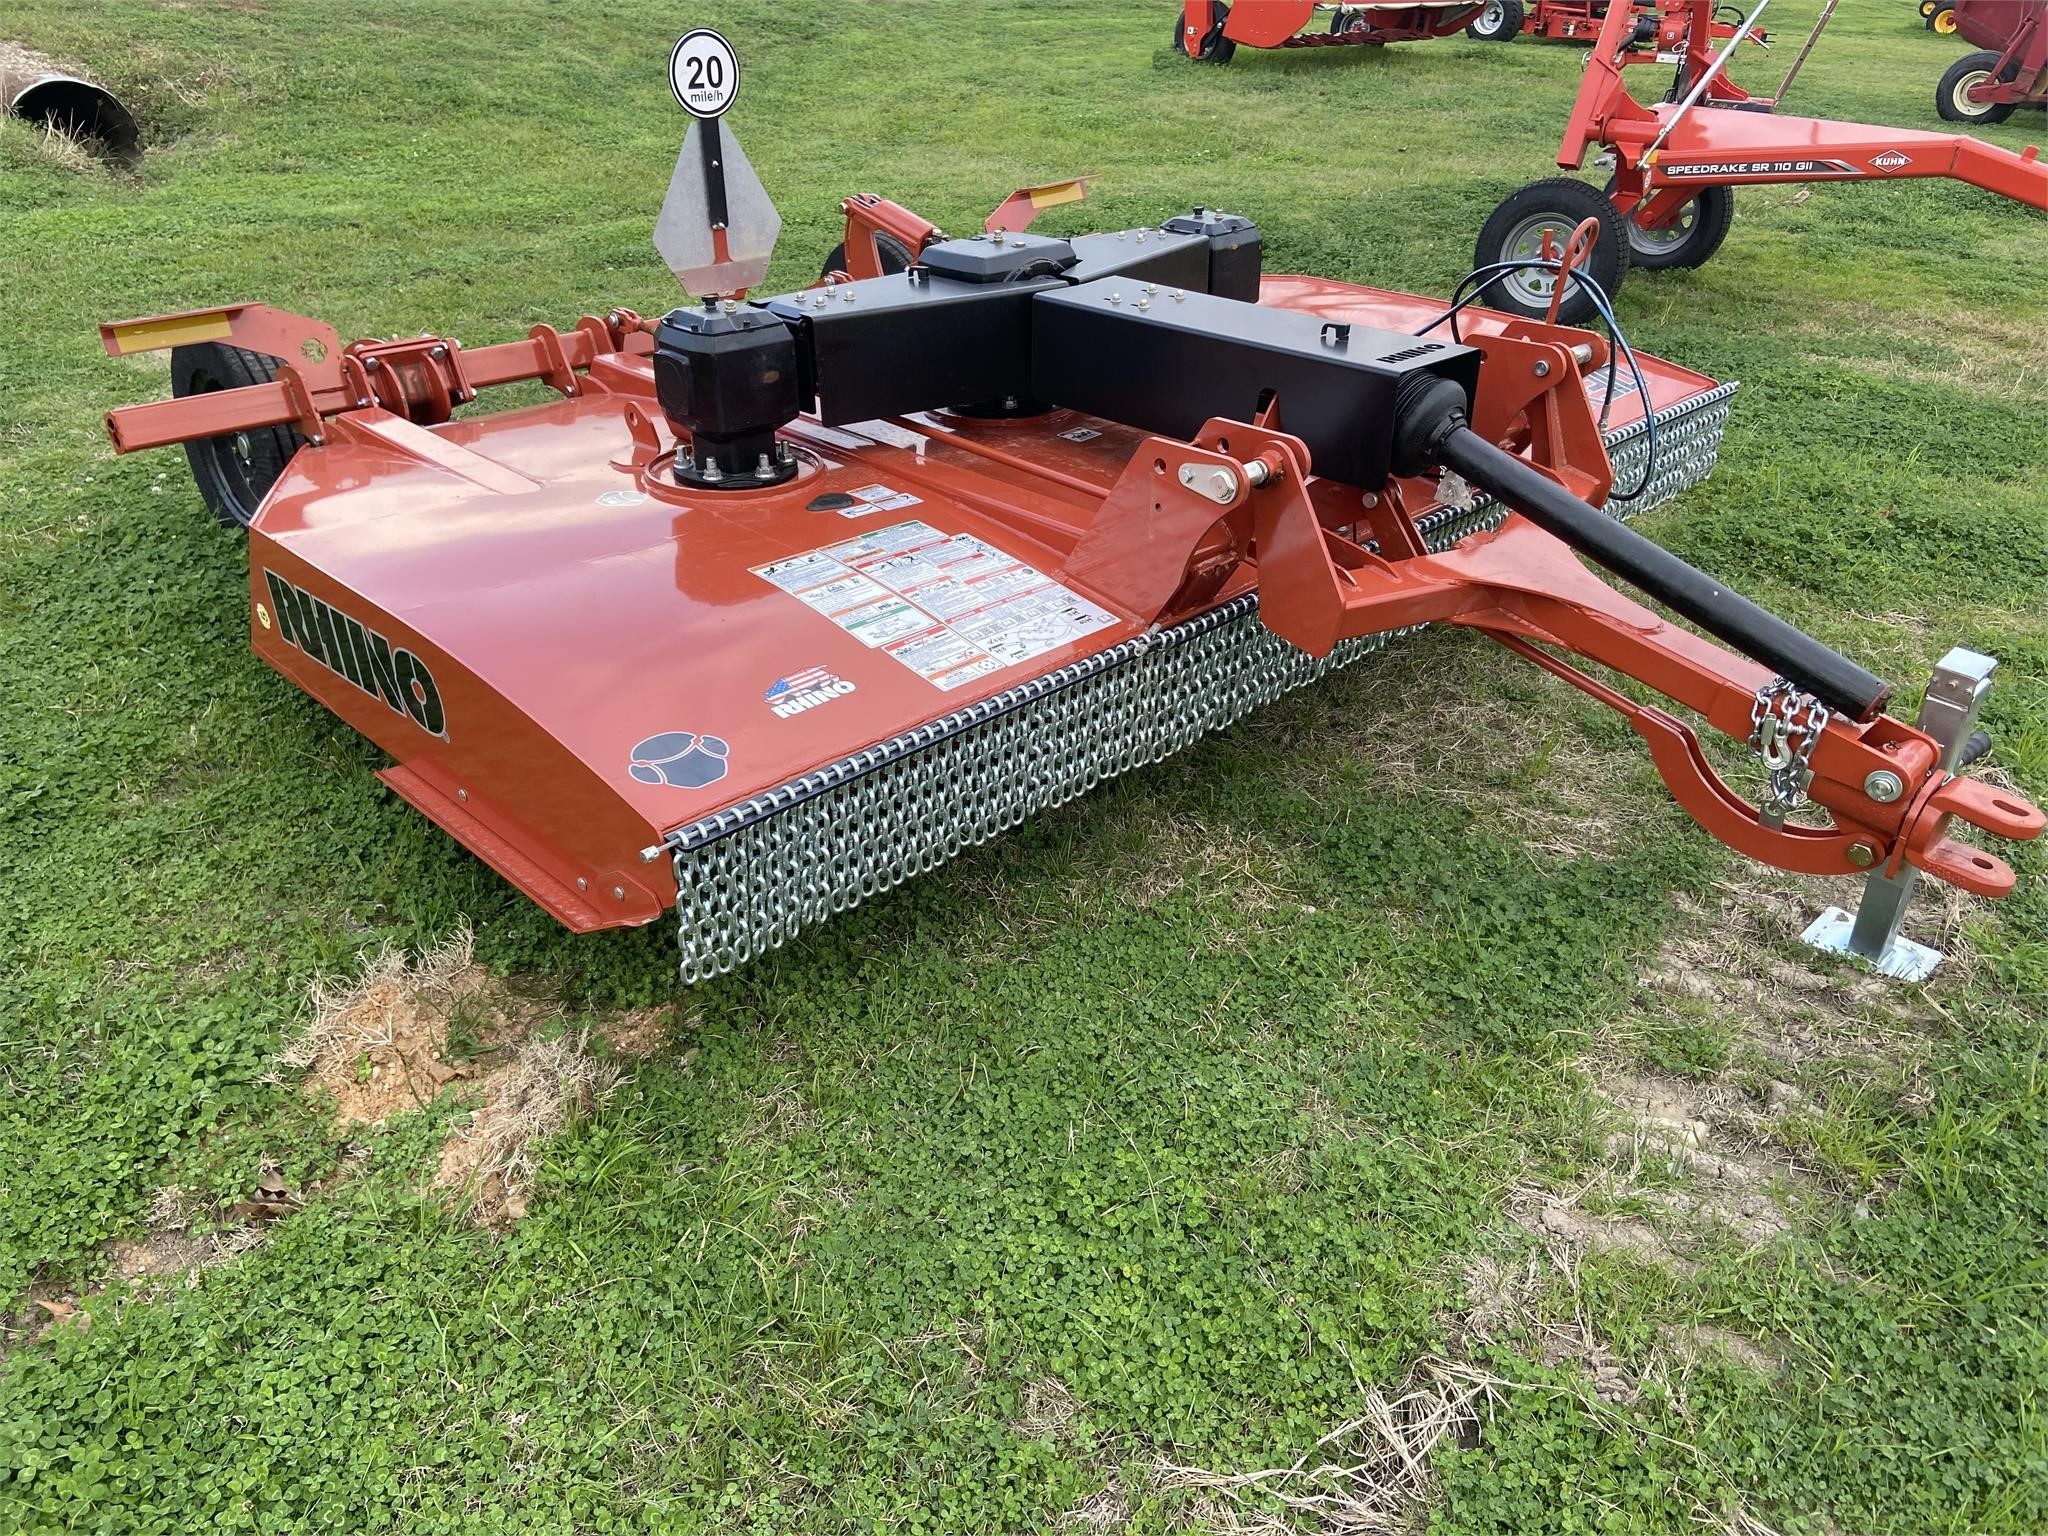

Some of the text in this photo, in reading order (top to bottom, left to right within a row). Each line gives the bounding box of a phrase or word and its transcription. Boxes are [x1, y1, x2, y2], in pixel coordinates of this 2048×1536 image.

[686, 55, 723, 90] 20
[690, 90, 724, 103] mile/h
[1666, 161, 1814, 175] SPEEDRAKE SR 110 GII
[1874, 156, 1907, 167] KUHN
[262, 566, 446, 738] RHINO
[770, 678, 857, 719] RHINO
